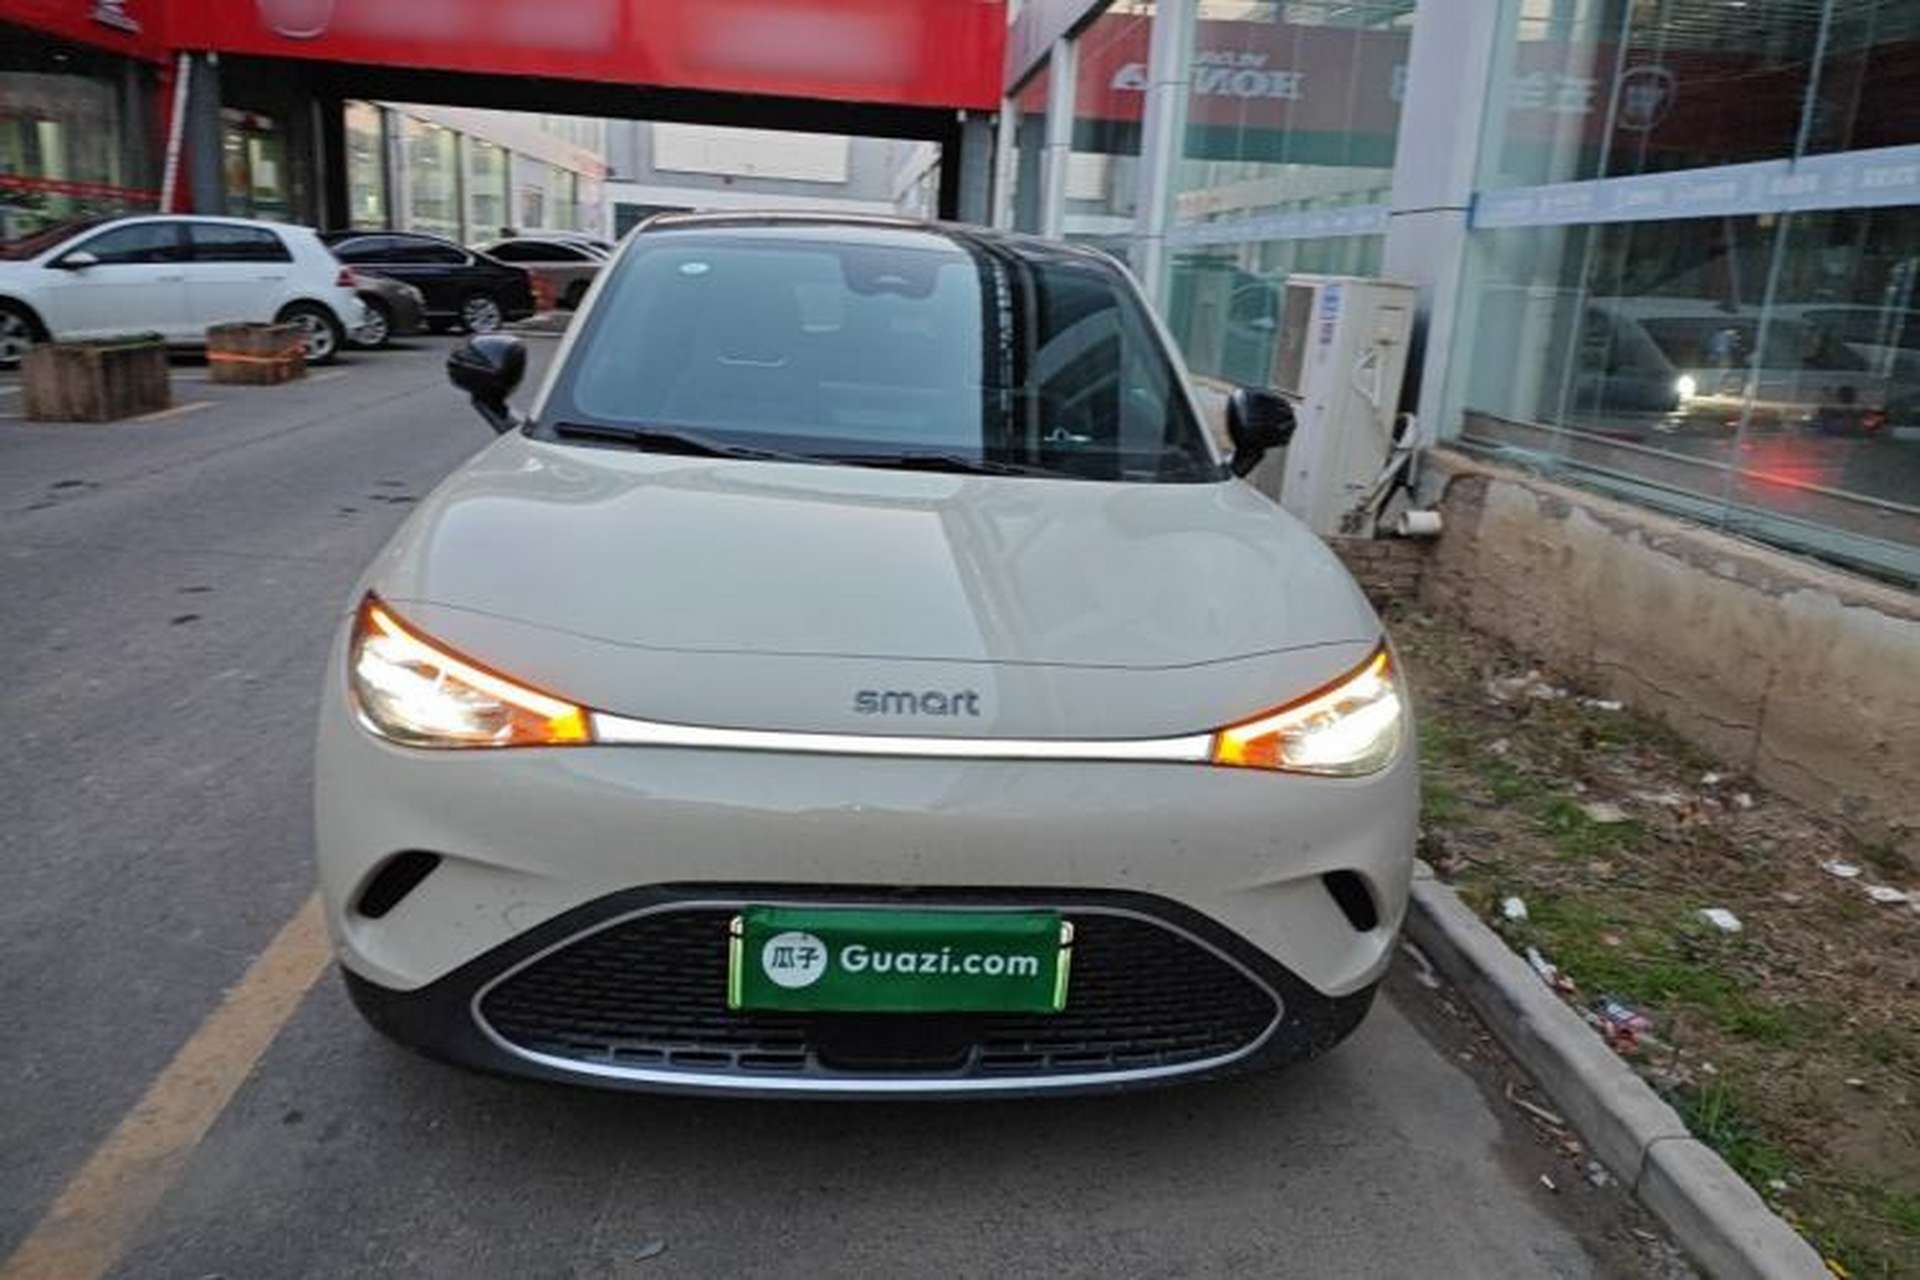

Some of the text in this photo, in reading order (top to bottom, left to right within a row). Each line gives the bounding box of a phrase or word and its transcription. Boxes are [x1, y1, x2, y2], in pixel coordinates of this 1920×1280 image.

[854, 689, 980, 716] smart
[771, 945, 820, 970] 瓜子
[841, 944, 1039, 976] Guazi.com
